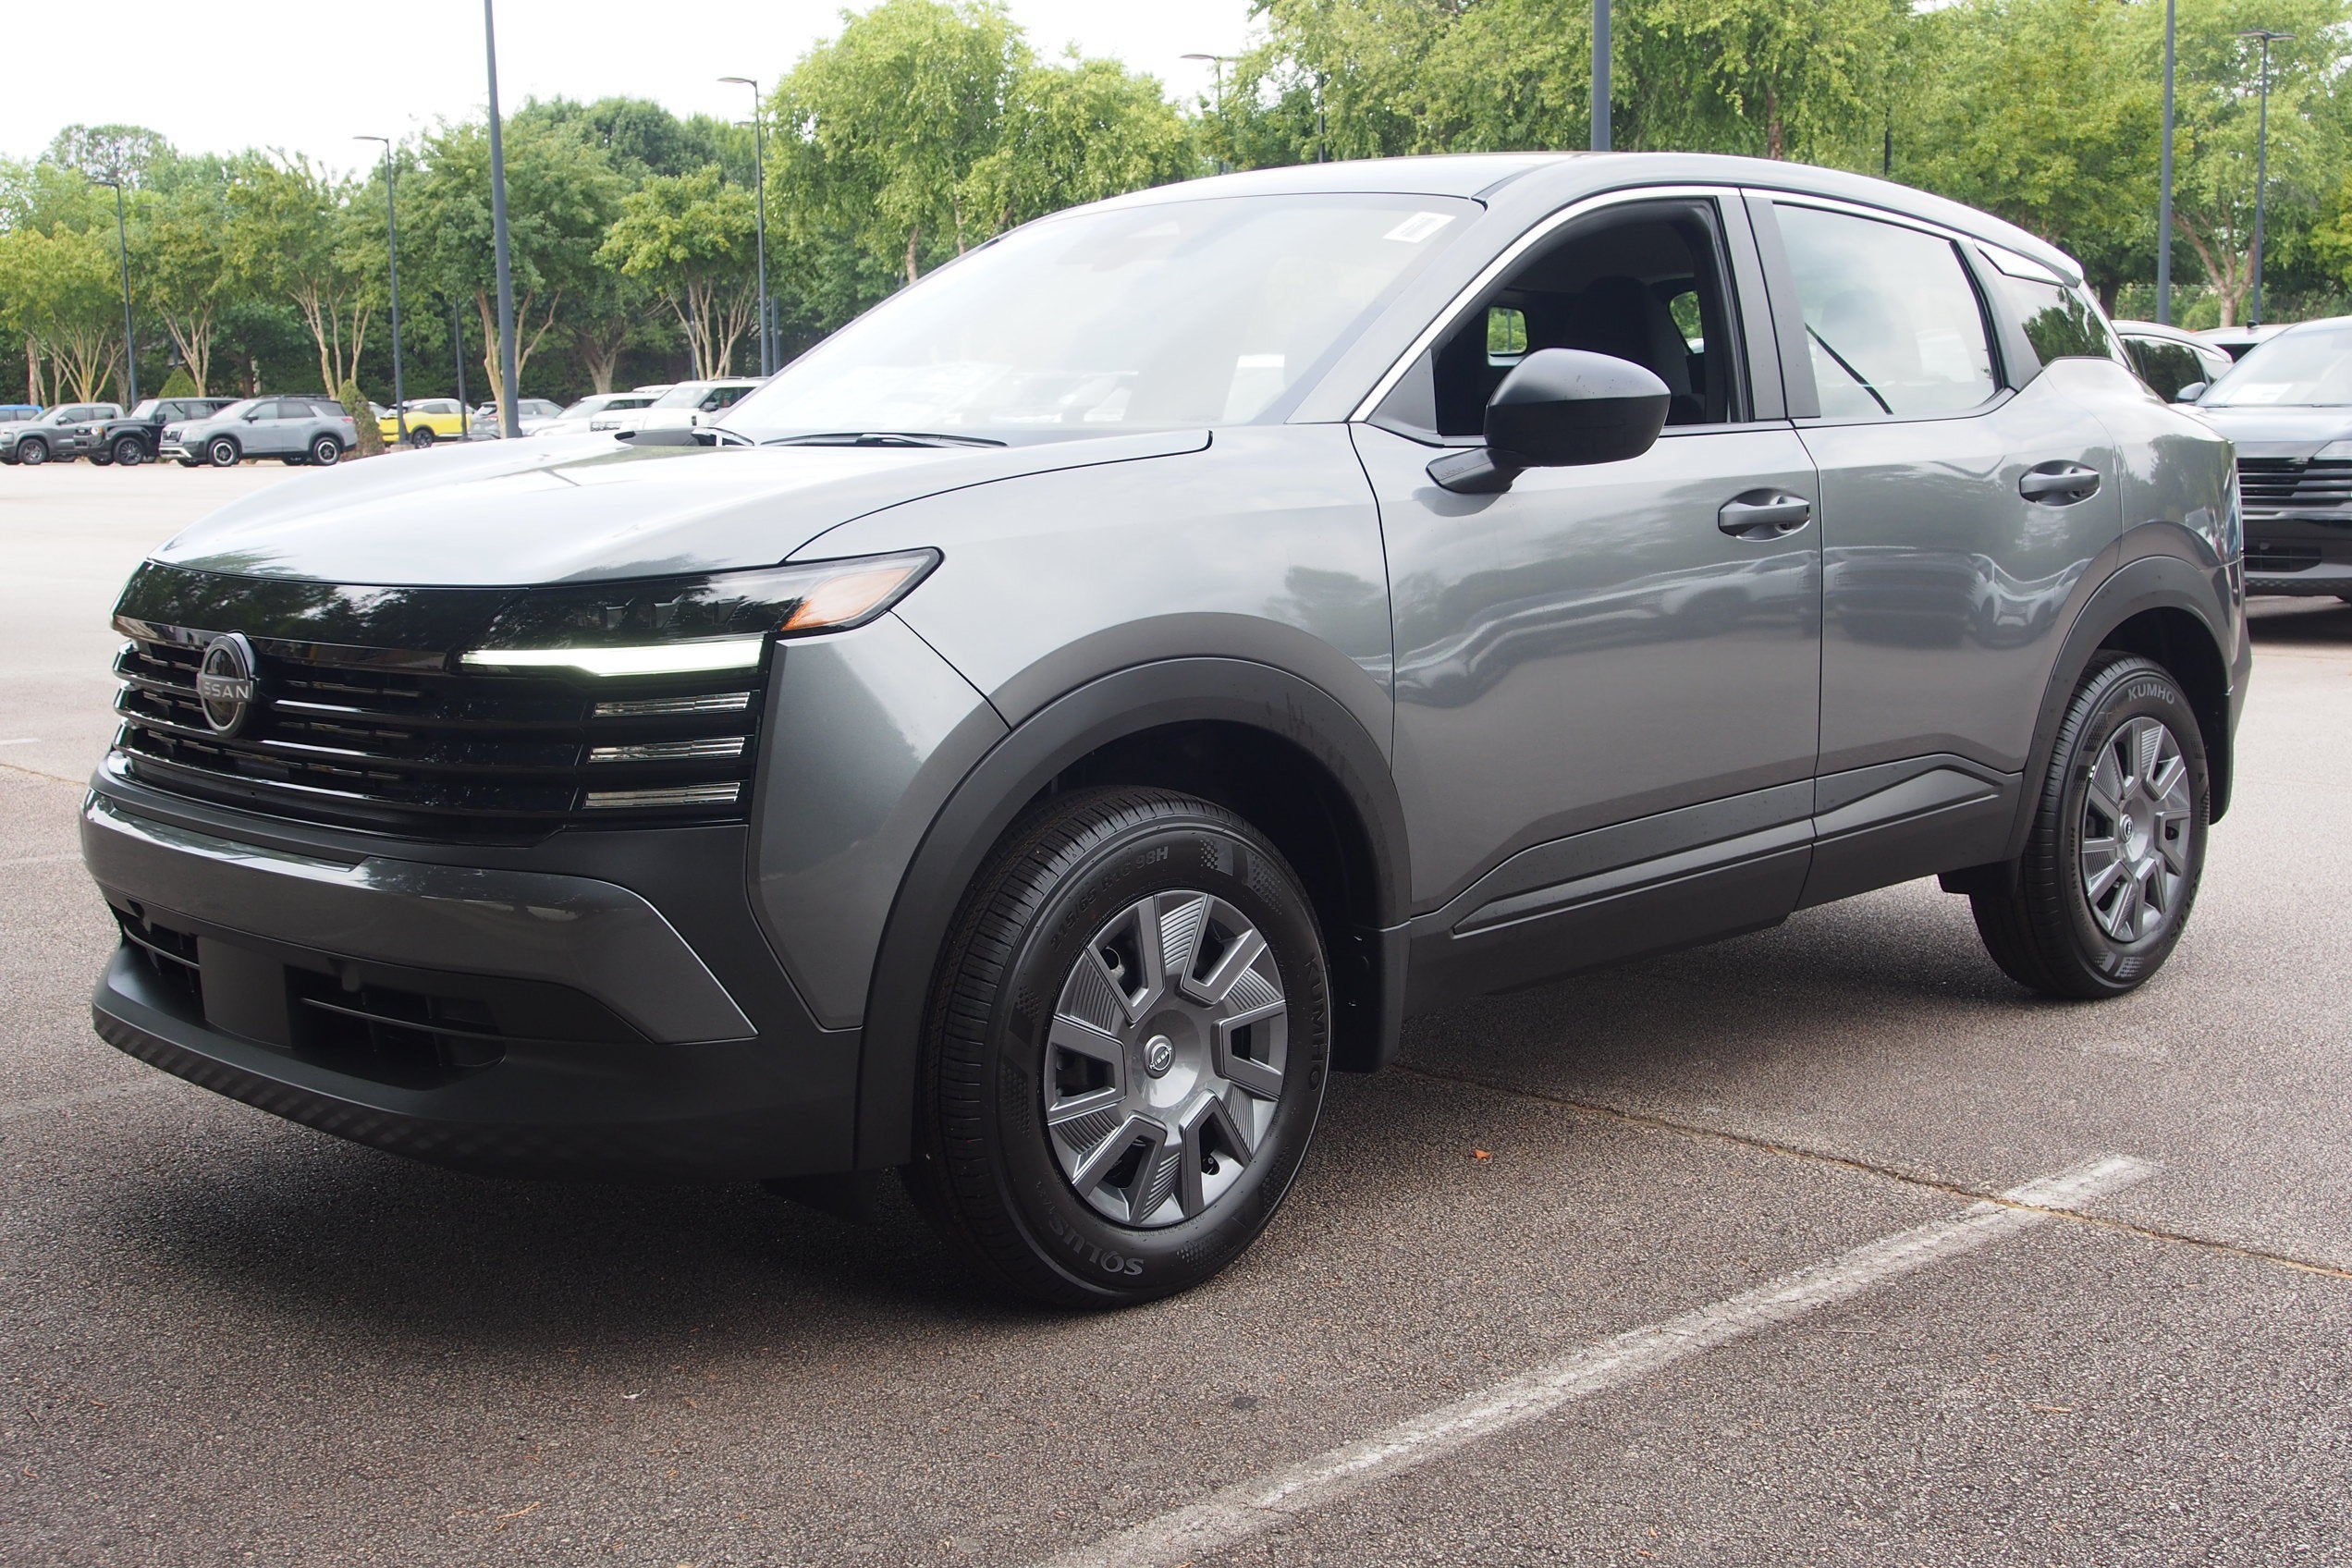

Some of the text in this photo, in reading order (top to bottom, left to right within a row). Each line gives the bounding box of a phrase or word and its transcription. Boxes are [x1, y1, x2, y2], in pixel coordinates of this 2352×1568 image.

[201, 680, 250, 699] SSAN
[2128, 682, 2175, 705] KUMHO
[1136, 845, 1168, 869] 98H
[1304, 956, 1325, 1093] KUMHO
[1149, 1045, 1172, 1070] NISSAN
[1047, 1208, 1145, 1277] SOLUS
